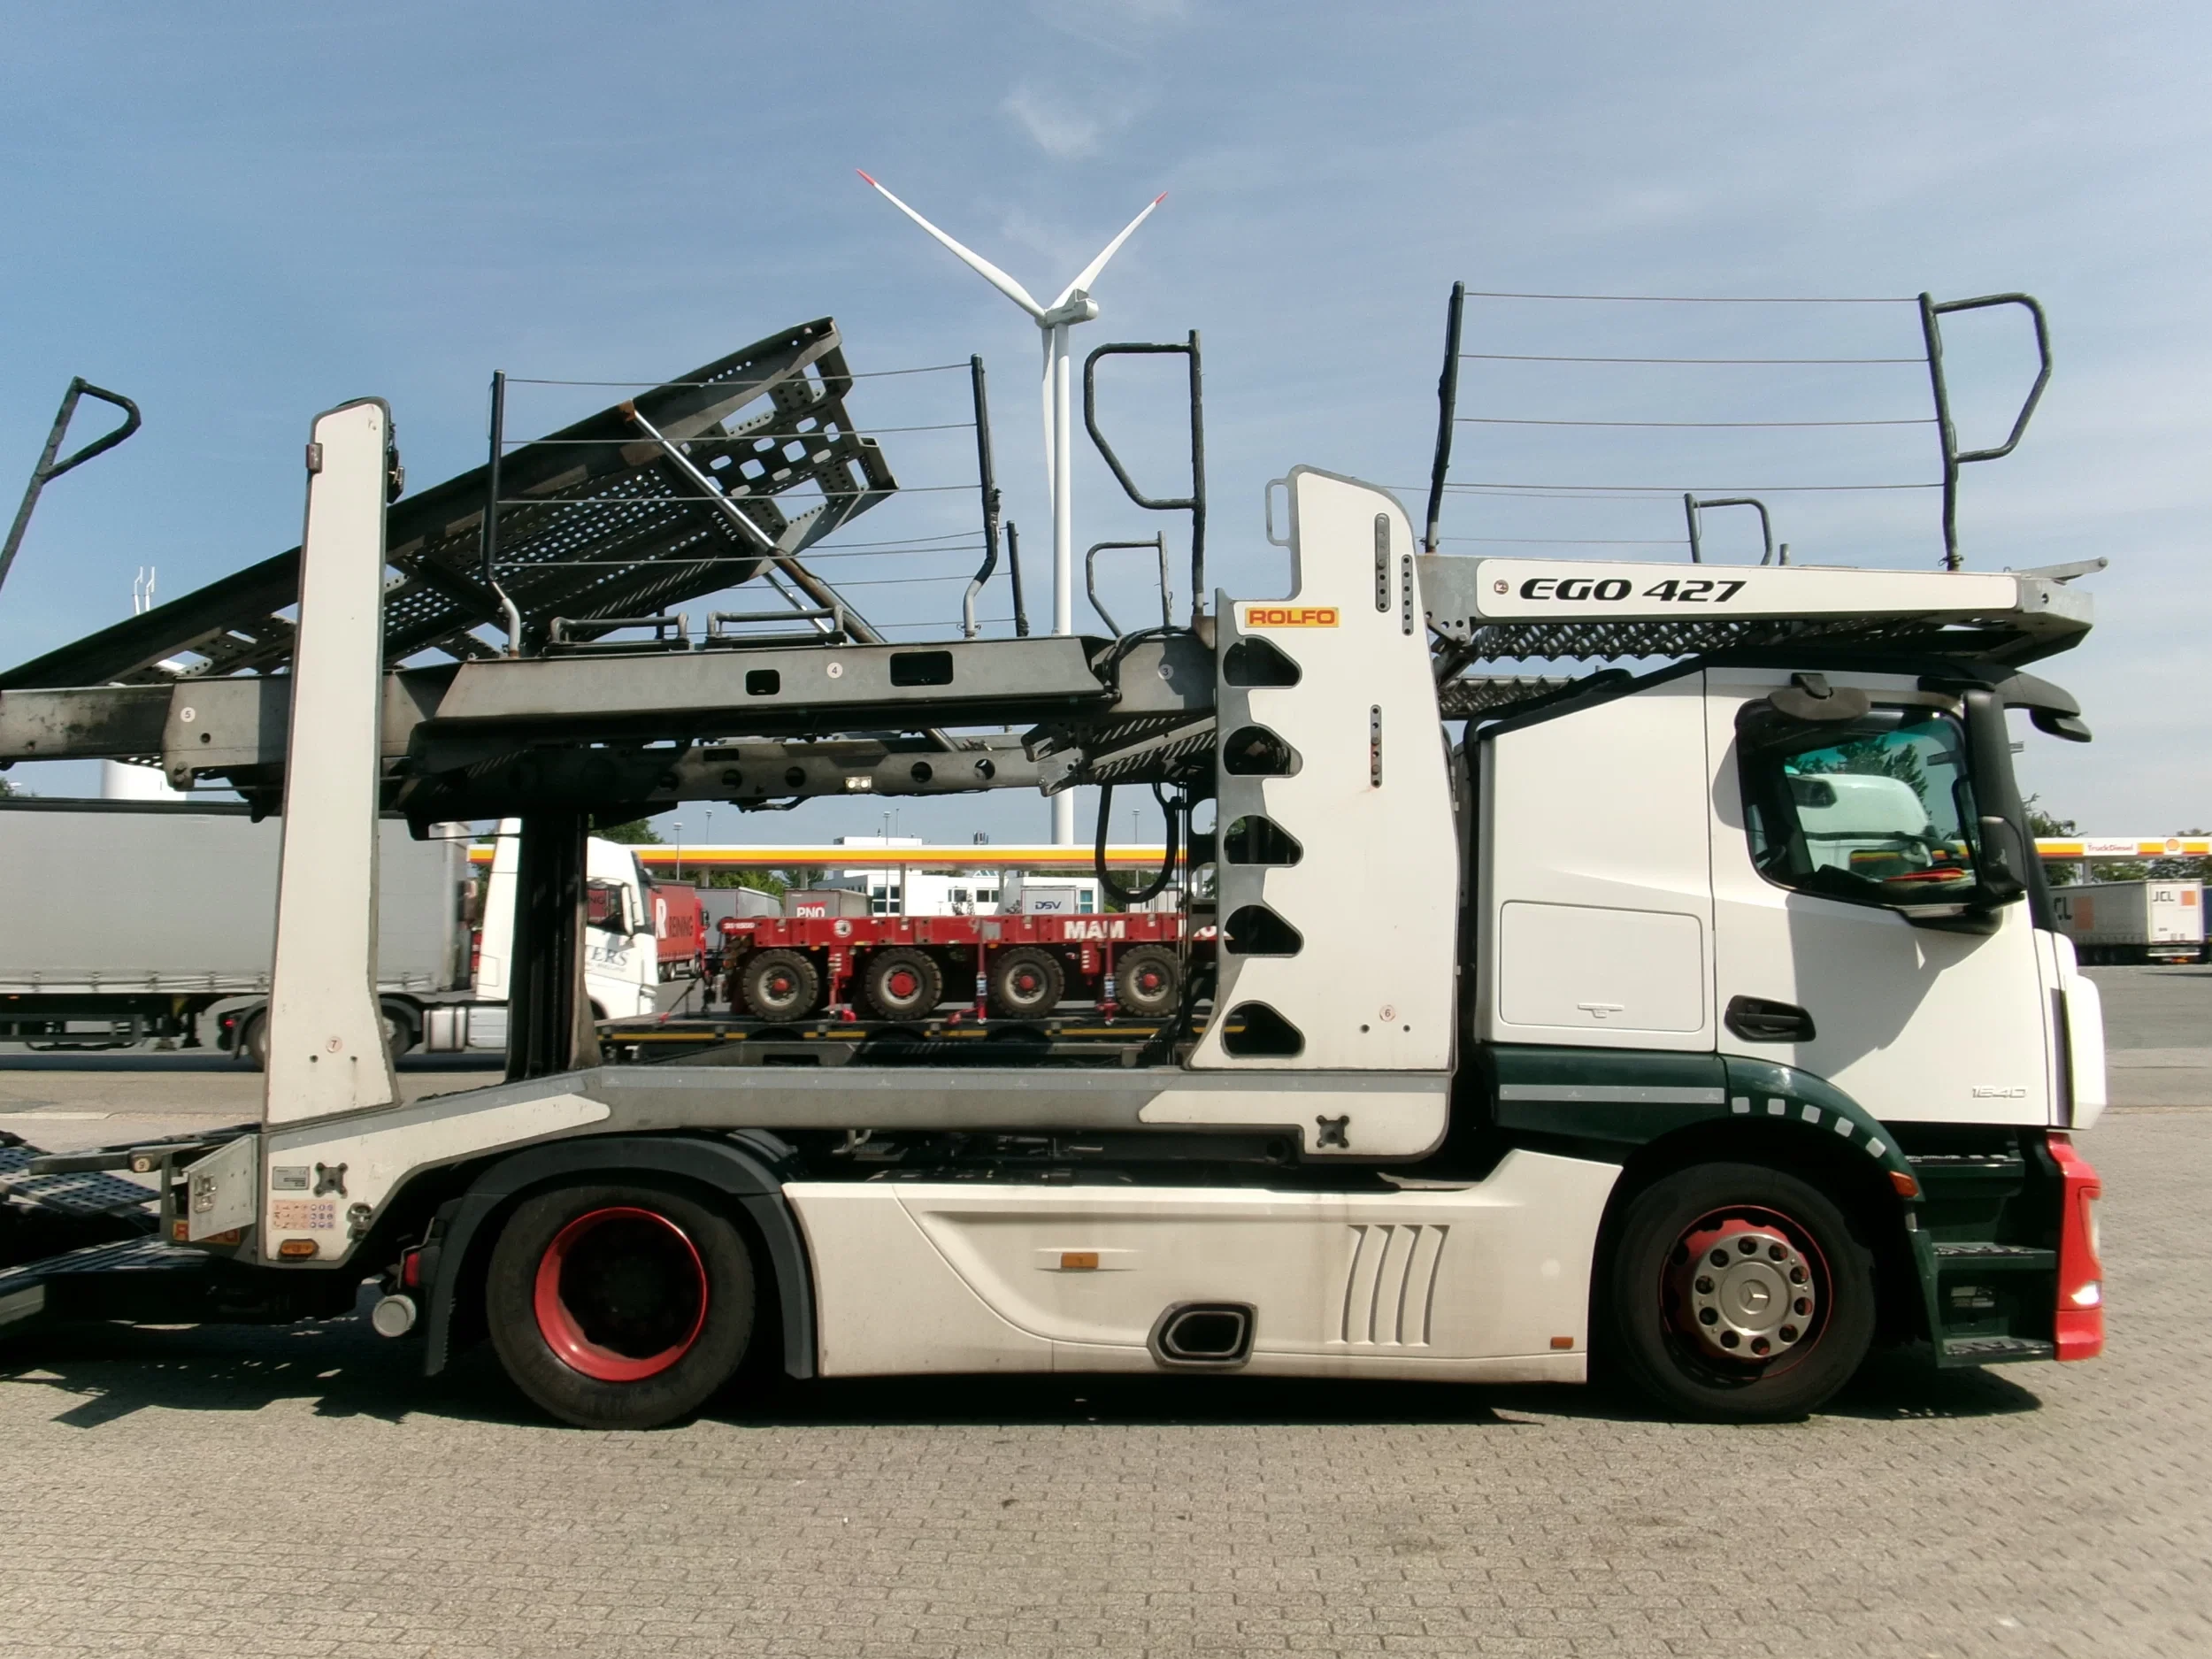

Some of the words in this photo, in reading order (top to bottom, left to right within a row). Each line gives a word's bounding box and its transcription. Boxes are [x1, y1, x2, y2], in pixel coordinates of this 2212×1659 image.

[1520, 579, 1632, 600] EGO
[1642, 580, 1747, 602] 427
[1248, 610, 1335, 624] ROLFO
[185, 710, 191, 718] 5
[2153, 891, 2174, 902] JCL
[1034, 901, 1062, 910] DSV
[2053, 896, 2072, 920] CL
[796, 906, 826, 918] PNO
[589, 946, 629, 966] ERS
[1385, 1009, 1391, 1018] 6
[331, 1040, 337, 1048] 7
